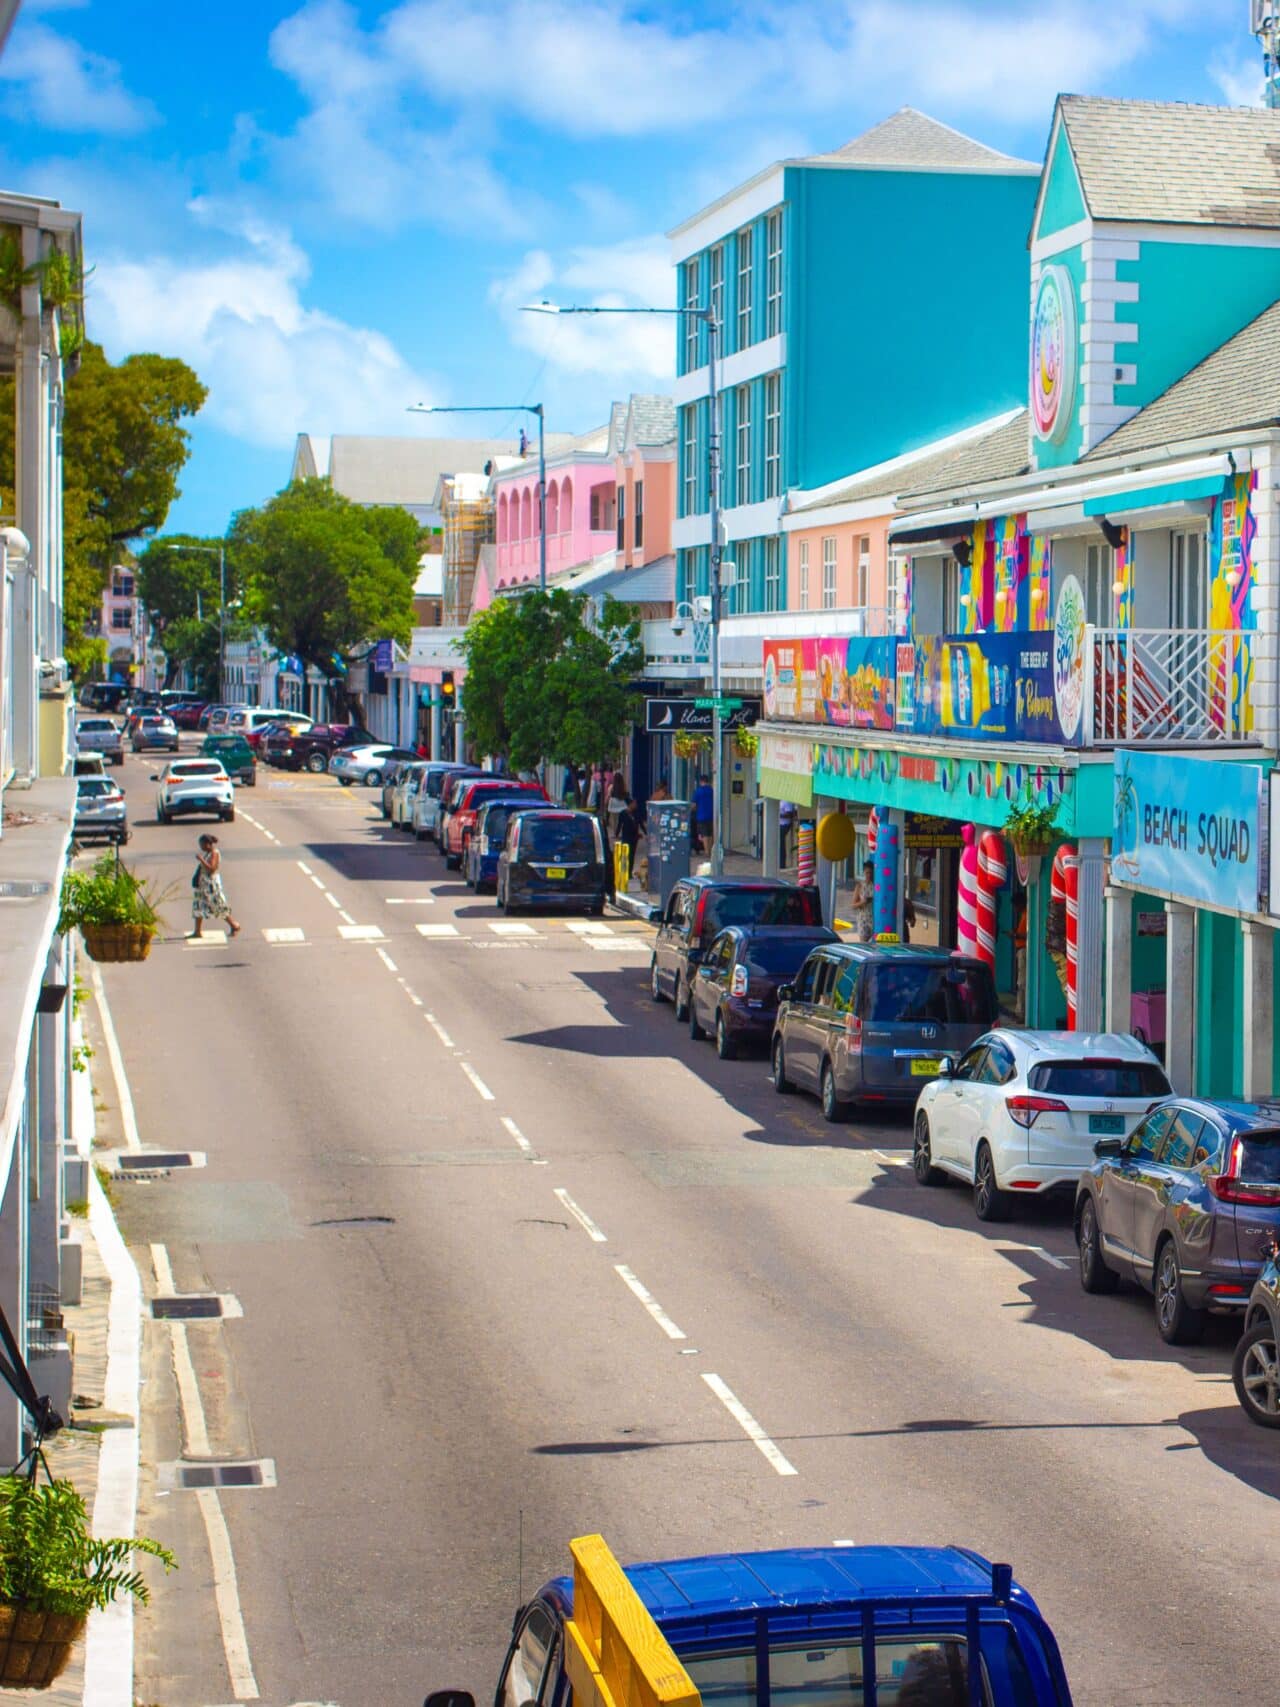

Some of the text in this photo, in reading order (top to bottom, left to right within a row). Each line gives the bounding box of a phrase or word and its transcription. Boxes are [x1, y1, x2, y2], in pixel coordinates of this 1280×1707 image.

[1020, 651, 1049, 669] THE BEER OF
[1143, 803, 1250, 867] BEACH SQUAD
